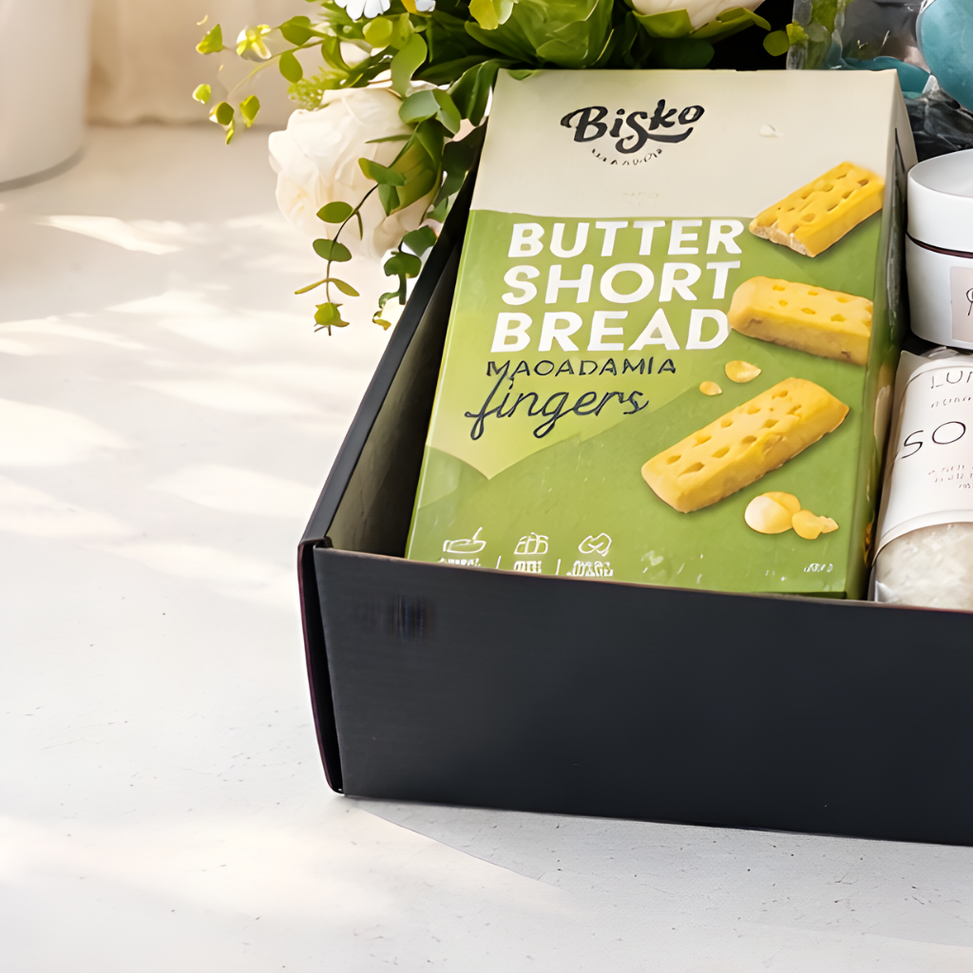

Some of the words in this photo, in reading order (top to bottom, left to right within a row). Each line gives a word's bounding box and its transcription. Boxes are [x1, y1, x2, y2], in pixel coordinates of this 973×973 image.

[560, 99, 705, 154] Bisko
[507, 218, 744, 259] BUTTER
[500, 260, 742, 306] SHORT
[489, 308, 731, 354] BREAD
[464, 373, 651, 440] fingers
